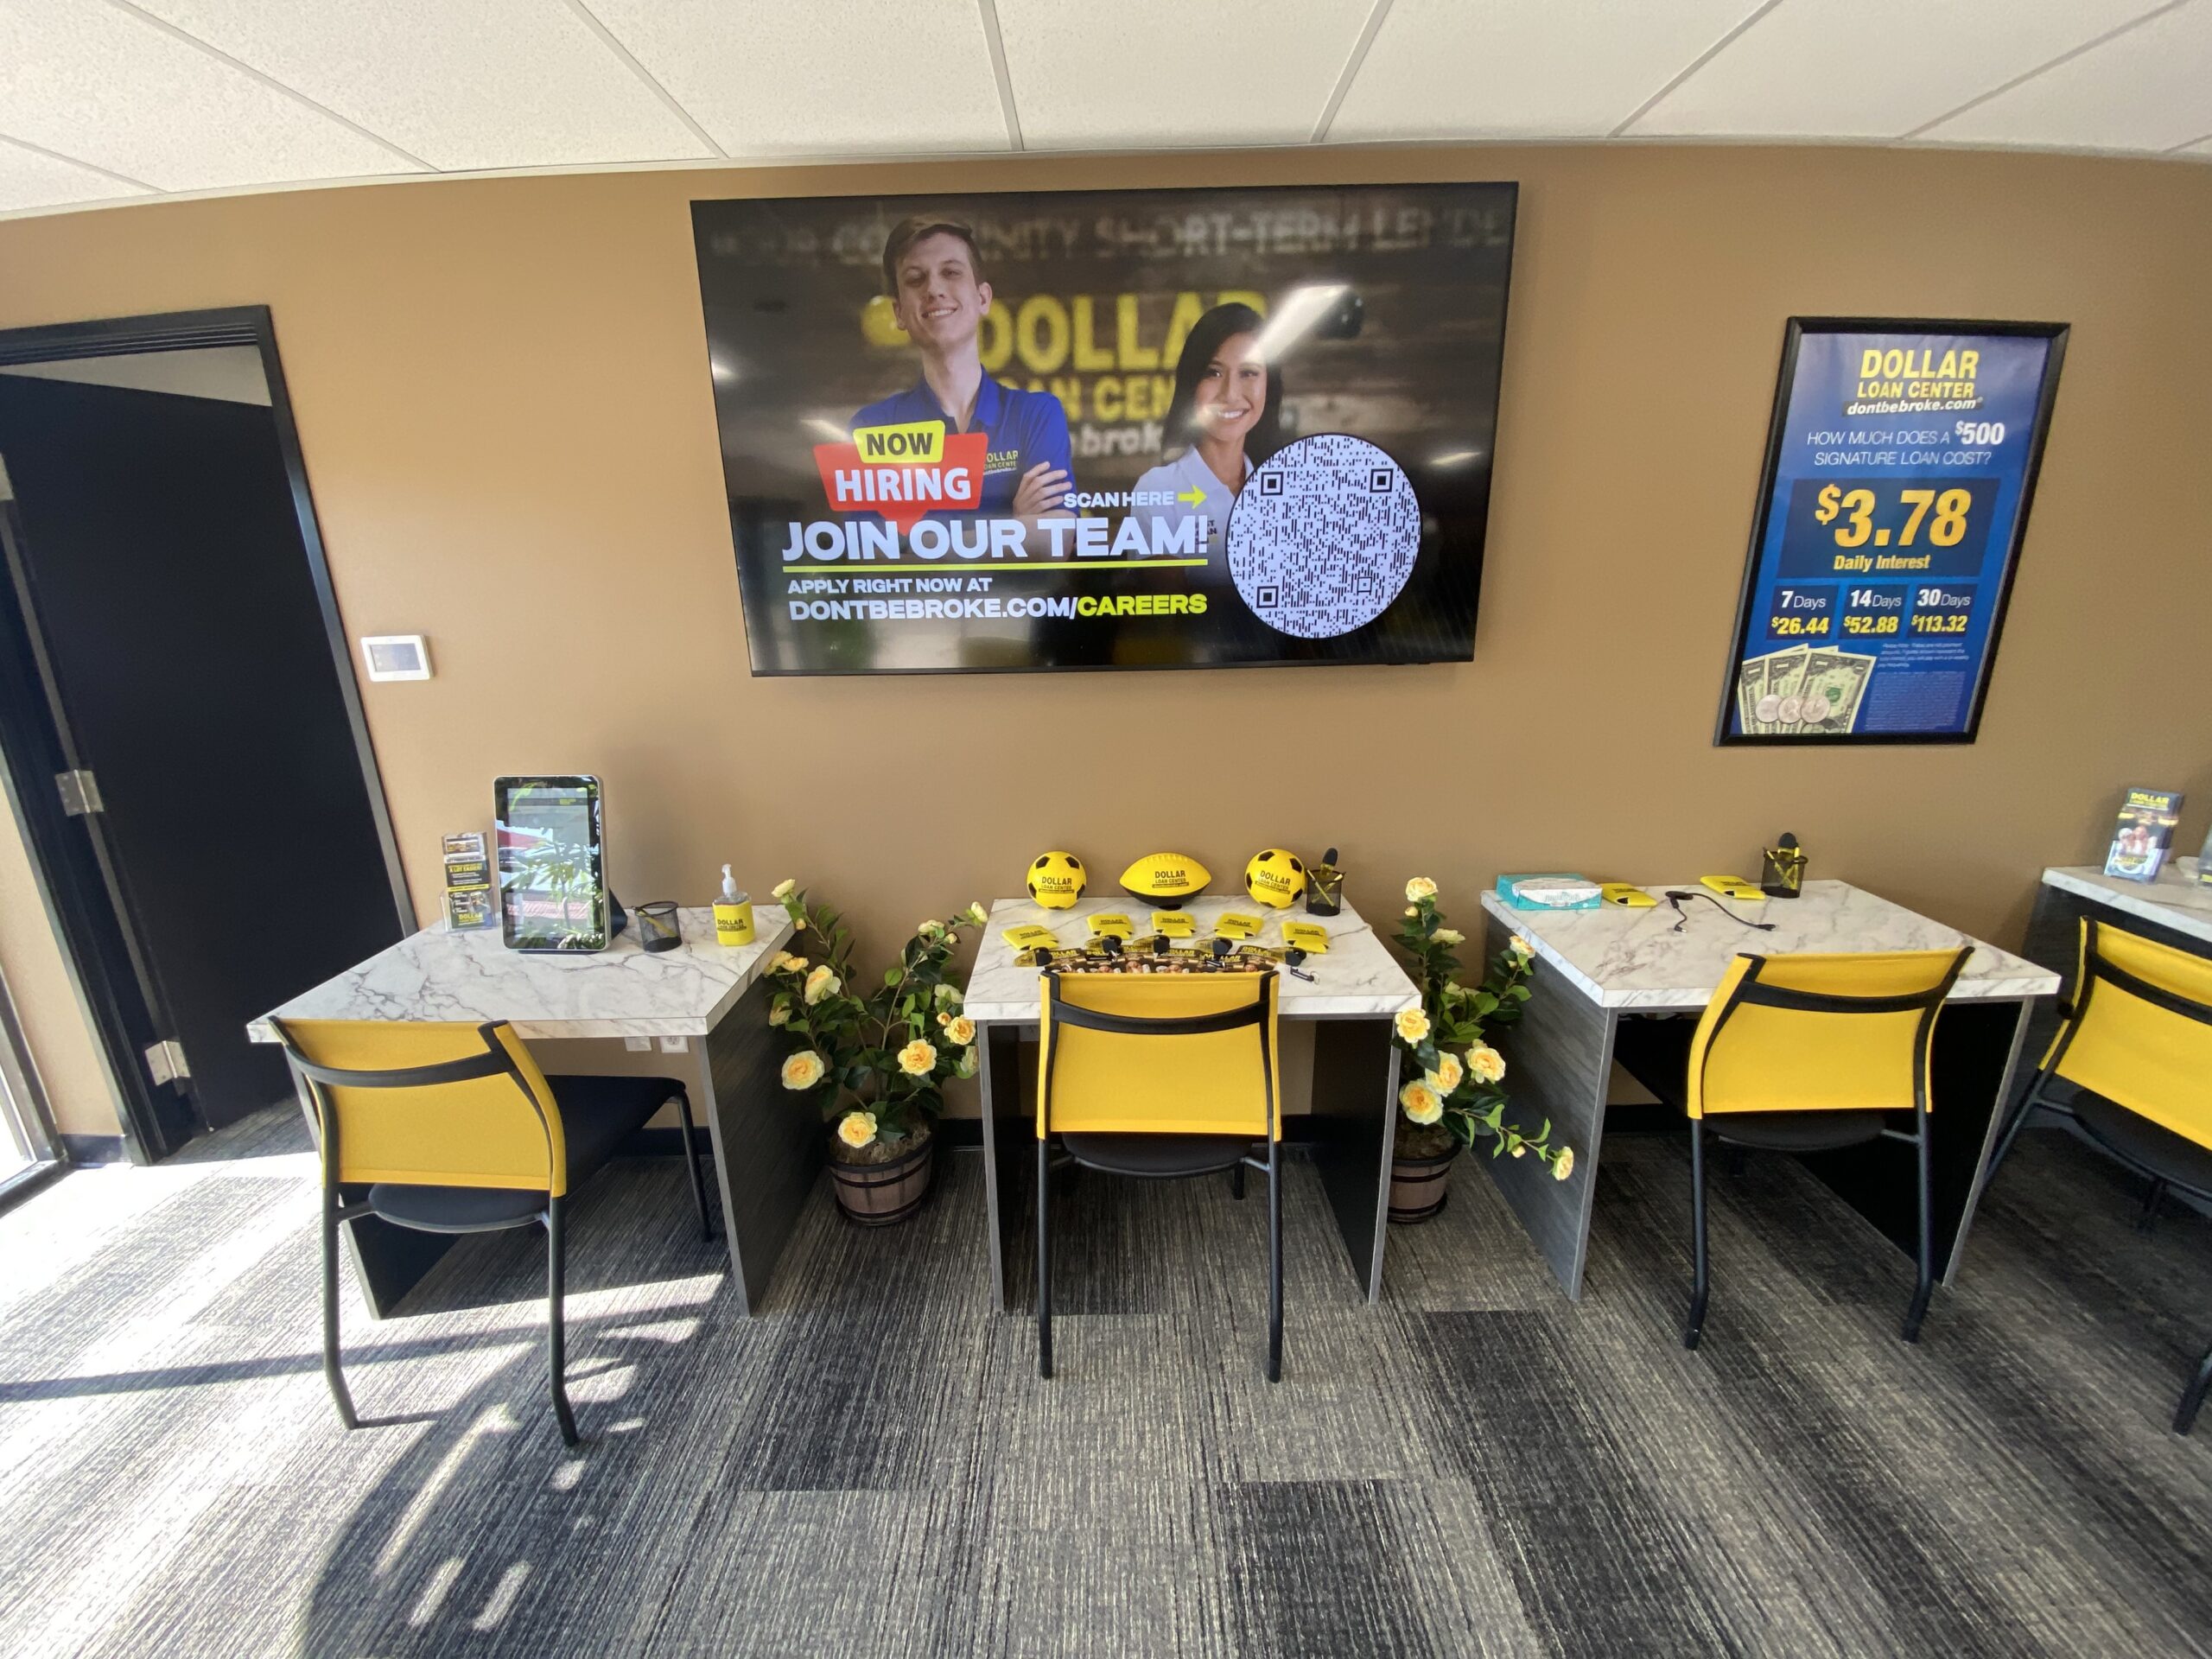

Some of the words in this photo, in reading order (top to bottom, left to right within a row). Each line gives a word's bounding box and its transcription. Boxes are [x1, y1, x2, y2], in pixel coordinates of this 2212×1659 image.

[978, 290, 1267, 373] DOLLA
[1859, 349, 1980, 378] DOLLAR
[1857, 382, 1904, 398] LOAN
[1908, 382, 1974, 398] CENTER
[1847, 399, 1977, 416] dontbebroke.com
[1807, 431, 1845, 445] HOW
[1848, 431, 1893, 444] MUCH
[1897, 431, 1937, 444] DOES
[1939, 432, 1950, 444] A
[1955, 421, 2005, 445] $500
[867, 433, 933, 455] NOW
[1815, 451, 1897, 465] SIGNATURE
[1901, 451, 1940, 465] LOAN
[1943, 451, 1992, 465] COST?
[835, 467, 971, 501] HIRING
[1064, 493, 1120, 508] SCAN
[1122, 491, 1174, 506] HERE
[1815, 484, 1973, 547] $3.78
[782, 520, 900, 561] JOIN
[909, 519, 1028, 559] OUR
[1037, 515, 1208, 557] TEAM!
[1834, 556, 1873, 572] Daily
[1876, 555, 1931, 569] Interest
[788, 579, 849, 594] APPLY
[853, 579, 912, 594] RIGHT
[916, 577, 962, 593] NOW
[966, 577, 993, 592] AT
[1780, 590, 1794, 608] 7
[1793, 595, 1827, 610] Days
[1851, 589, 1872, 607] 14
[1872, 594, 1902, 608] Days
[1916, 588, 1940, 607] 30
[1940, 594, 1971, 607] Days
[789, 594, 1208, 620] DONTBEBROKE.COM/CAREERS
[1771, 617, 1829, 635] $26.44
[1843, 616, 1899, 634] $52.88
[1911, 614, 1967, 632] $113.32
[1042, 876, 1072, 885] DOLLAR
[1154, 870, 1186, 879] DOLLAR
[1260, 870, 1291, 886] DOLLAR
